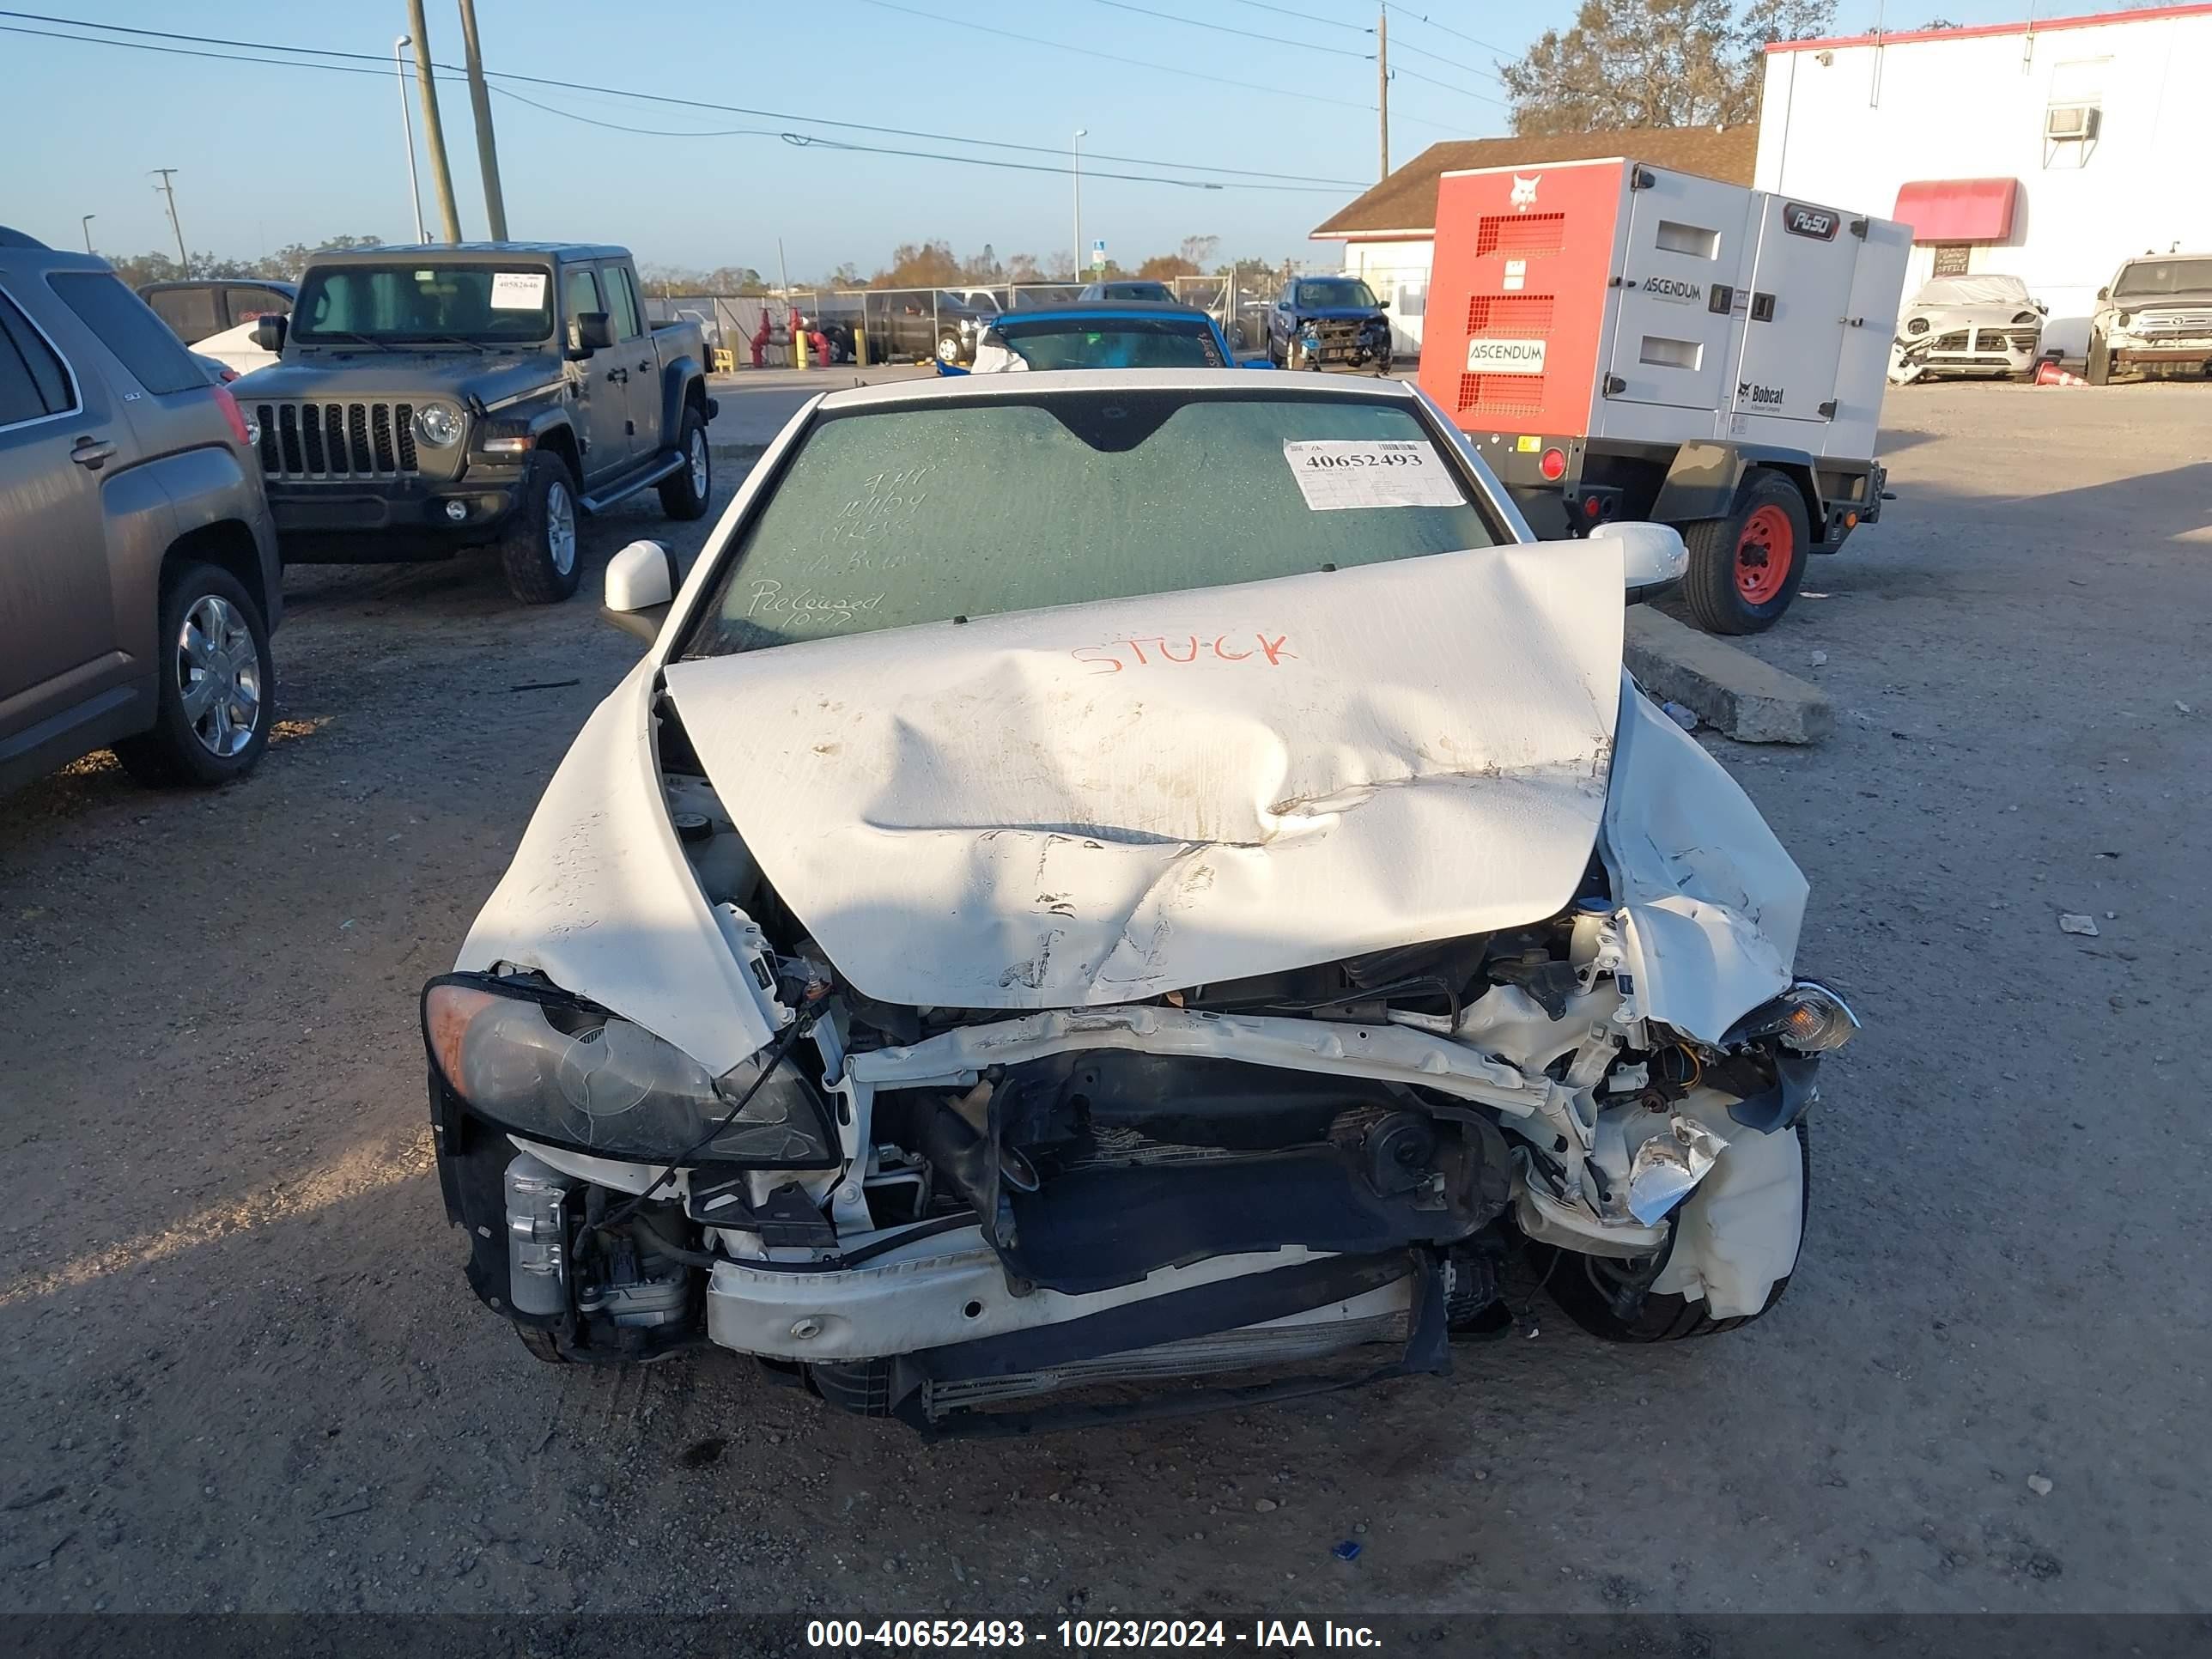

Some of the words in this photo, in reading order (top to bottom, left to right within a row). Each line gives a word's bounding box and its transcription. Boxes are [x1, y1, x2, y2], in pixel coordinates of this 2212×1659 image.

[1642, 276, 1701, 301] ASCENDUM
[1470, 344, 1542, 360] ASCENDUM
[1752, 385, 1784, 404] Bobcat
[1305, 453, 1423, 468] 40652493
[1071, 633, 1299, 675] STUCK
